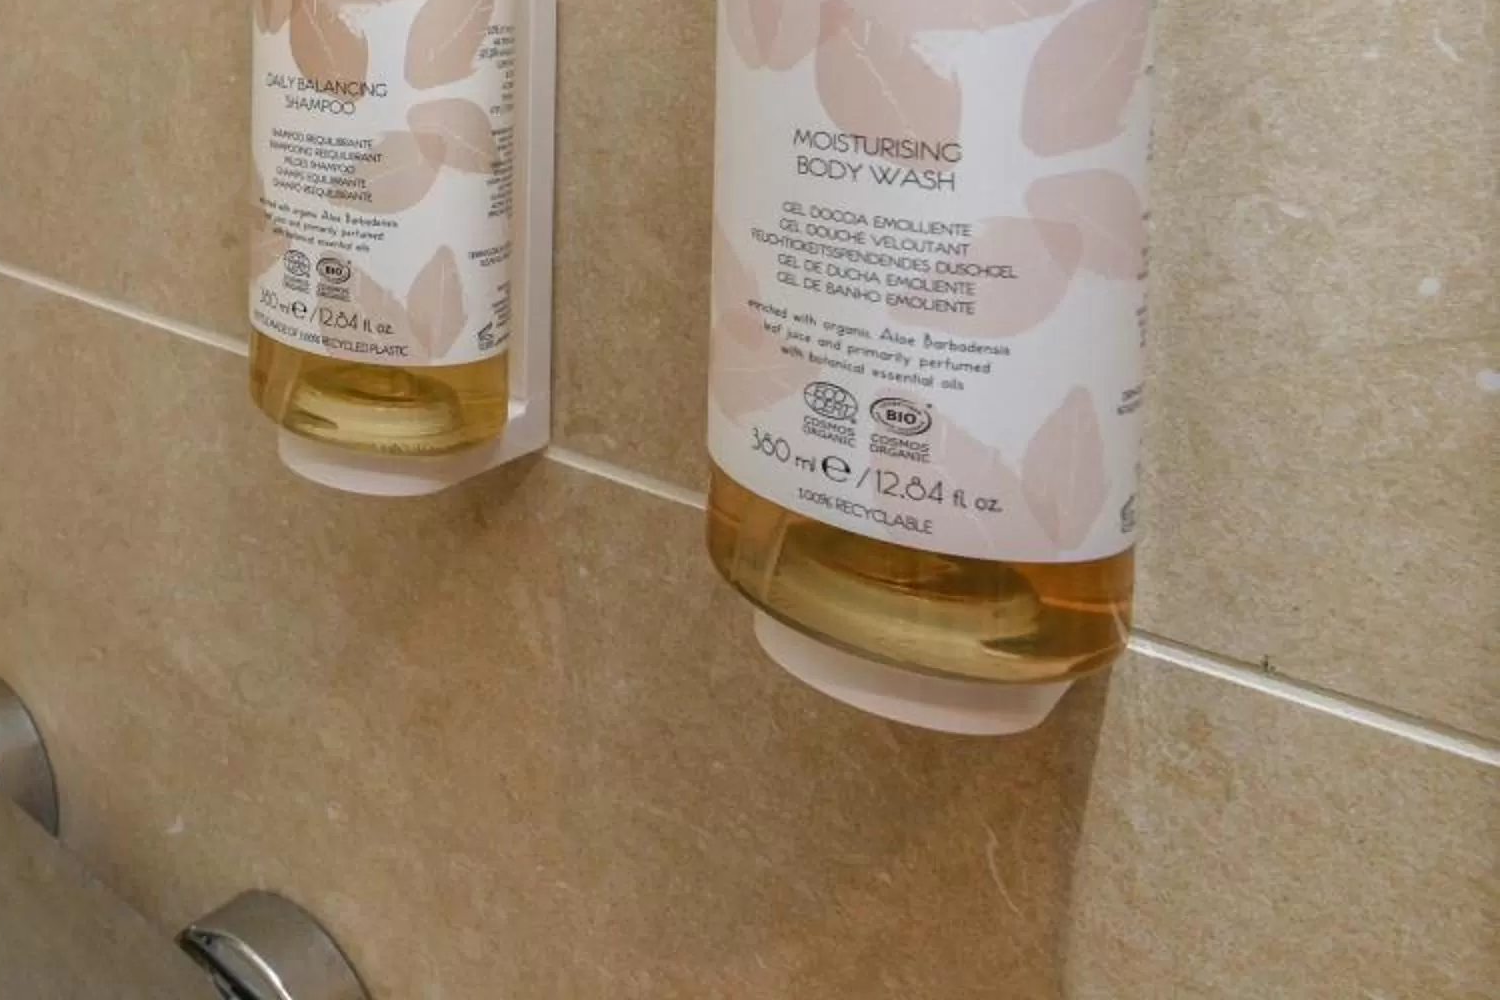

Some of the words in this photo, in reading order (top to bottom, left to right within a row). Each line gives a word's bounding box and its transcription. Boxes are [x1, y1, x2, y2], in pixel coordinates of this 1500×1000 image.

[285, 94, 356, 115] SHAMPOO
[297, 77, 388, 98] BALANCING
[793, 128, 963, 163] MOISTURISING
[797, 155, 863, 183] BODY
[869, 164, 955, 192] WASH
[779, 217, 800, 233] GEL
[806, 223, 865, 245] DOUCHE
[869, 234, 971, 257] VELOUTANT
[781, 201, 806, 216] GEL
[809, 204, 868, 226] DOCCIA
[873, 215, 973, 237] EMOLLIENTE
[777, 253, 801, 269] GEL
[803, 259, 822, 274] DE
[827, 263, 881, 284] DUCHA
[886, 272, 977, 297] EMOLIENTE
[935, 260, 1018, 279] DUSCHGEL
[776, 271, 800, 287] GEL
[803, 277, 821, 292] DE
[826, 281, 881, 302] BANHO
[886, 292, 976, 316] EMOLIENTE
[793, 312, 817, 326] with
[823, 320, 871, 338] organic
[880, 327, 915, 345] Aloe
[923, 332, 1010, 356] Barbadensis
[808, 350, 865, 374] botanical
[872, 368, 933, 388] essential
[941, 377, 964, 391] oils
[817, 338, 841, 351] and
[847, 344, 910, 367] primarily
[919, 357, 992, 375] perfumed
[886, 409, 916, 425] BIO
[870, 433, 930, 453] COSMOS
[870, 443, 931, 463] ORGANIC
[795, 455, 817, 472] ml
[953, 488, 968, 509] fl
[798, 487, 834, 509] 100%
[835, 497, 933, 534] RECYCLABLE
